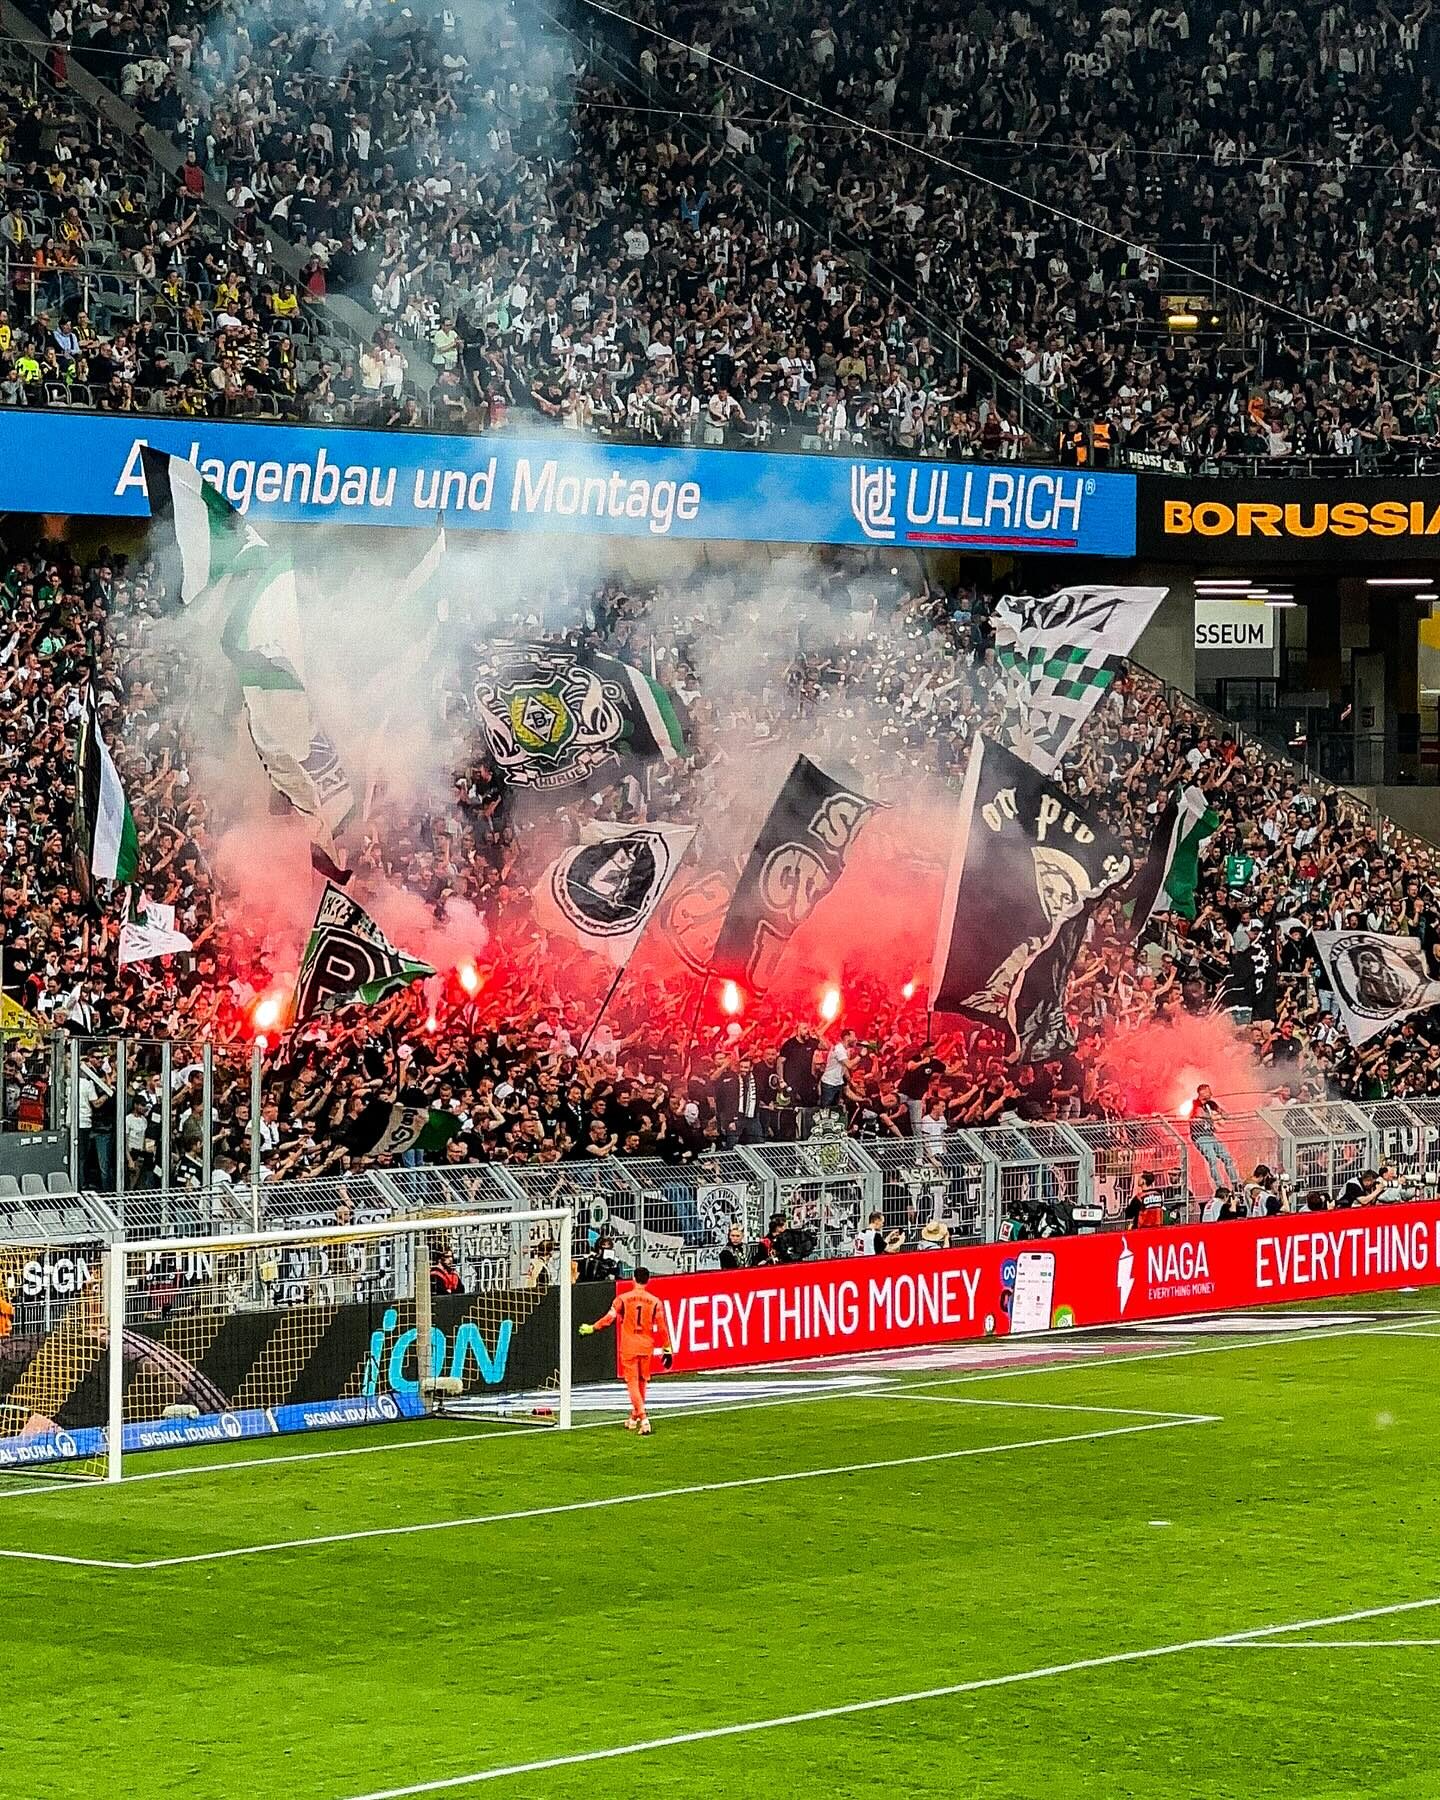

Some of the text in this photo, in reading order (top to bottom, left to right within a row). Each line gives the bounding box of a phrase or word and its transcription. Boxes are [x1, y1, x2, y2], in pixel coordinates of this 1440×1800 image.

[413, 458, 497, 511] und
[511, 459, 701, 534] Montage
[1148, 1241, 1209, 1284] NAGA
[1256, 1221, 1428, 1288] EVERYTHING
[1148, 1282, 1216, 1300] EVERYTHING MONEY
[636, 1305, 642, 1327] 1
[653, 1281, 859, 1356] VERYTHING
[869, 1268, 982, 1332] MONEY
[304, 1409, 345, 1427] SIGNAL
[140, 1426, 223, 1447] SIGNAL IDUNA
[19, 1443, 58, 1459] IDUNA
